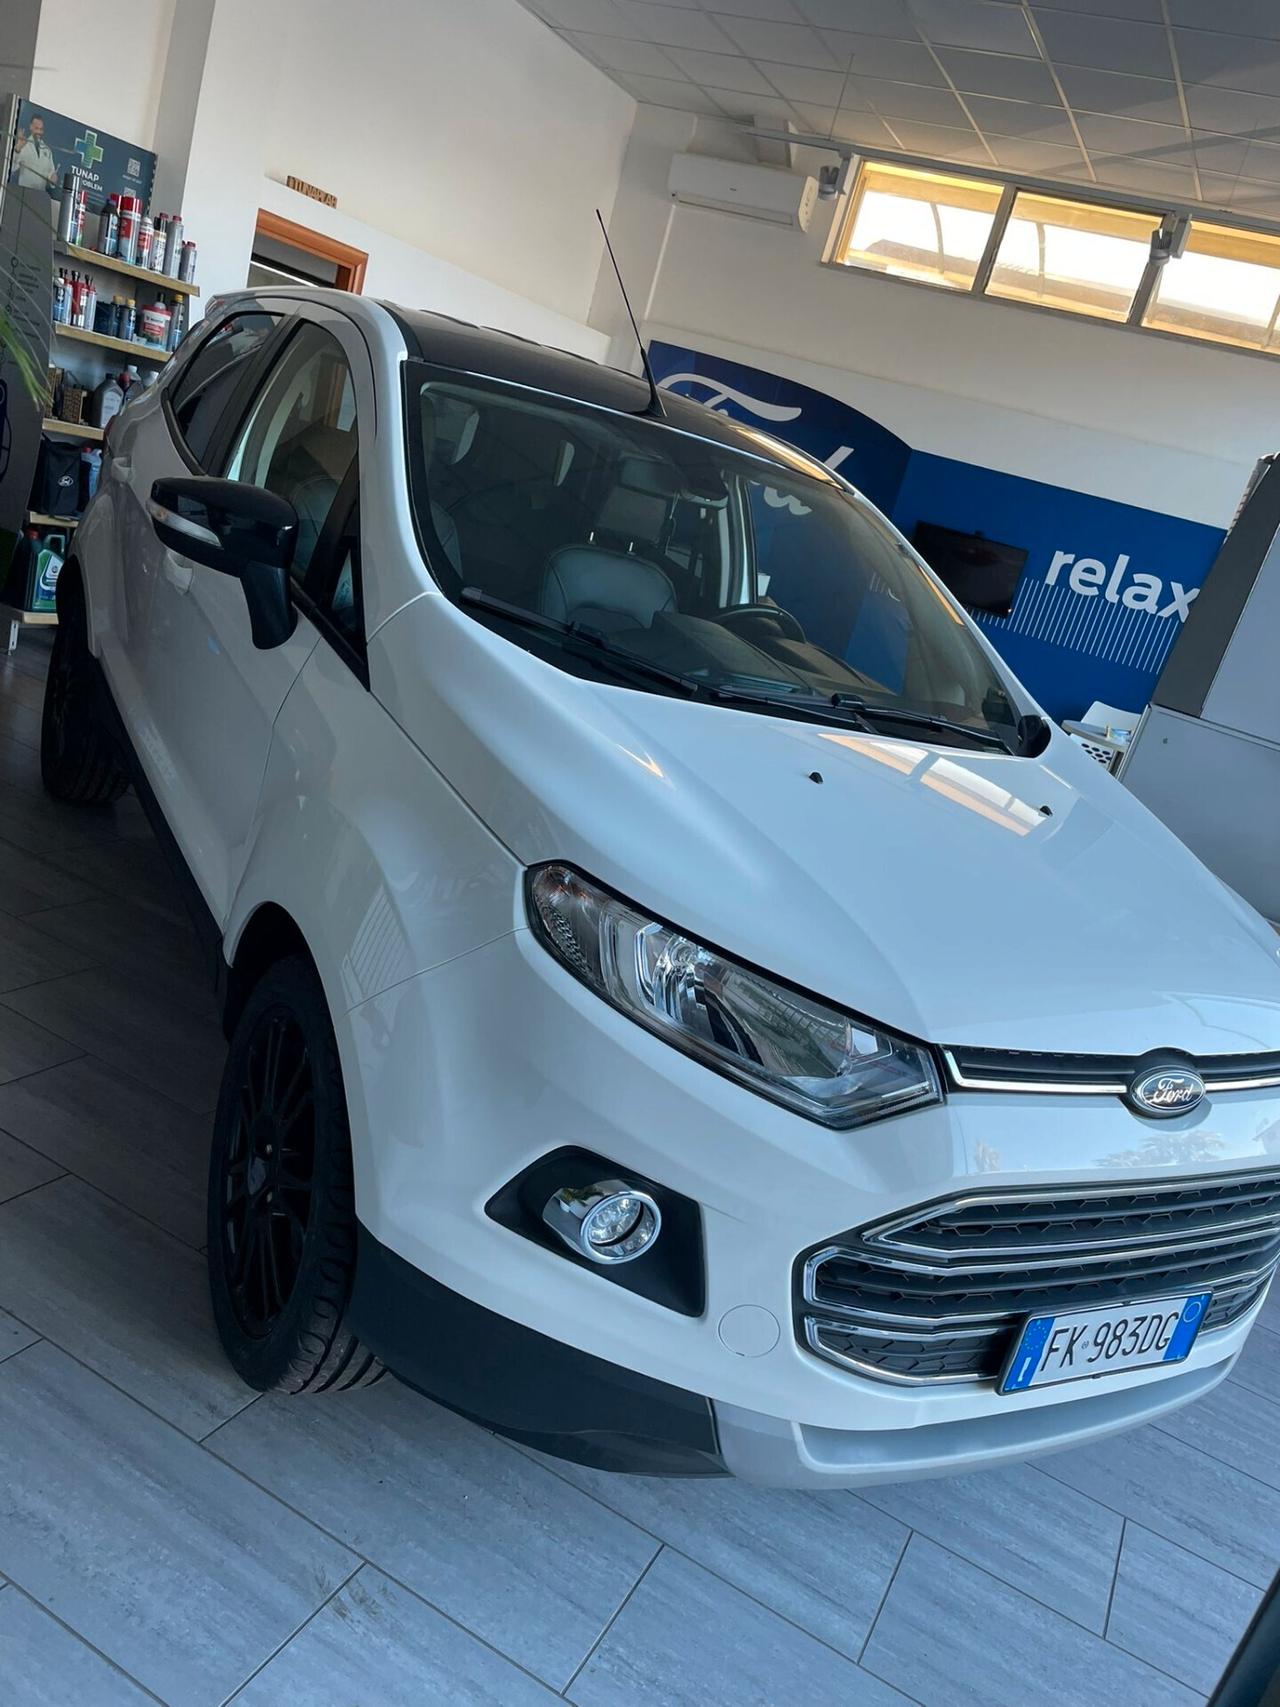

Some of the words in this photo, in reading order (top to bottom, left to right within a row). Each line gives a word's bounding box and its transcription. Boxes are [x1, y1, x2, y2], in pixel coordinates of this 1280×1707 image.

[71, 165, 100, 182] TUNAP
[81, 178, 103, 192] OBLEM
[1044, 551, 1201, 623] relax
[1147, 1077, 1194, 1104] Ford
[1041, 1324, 1089, 1373] FK
